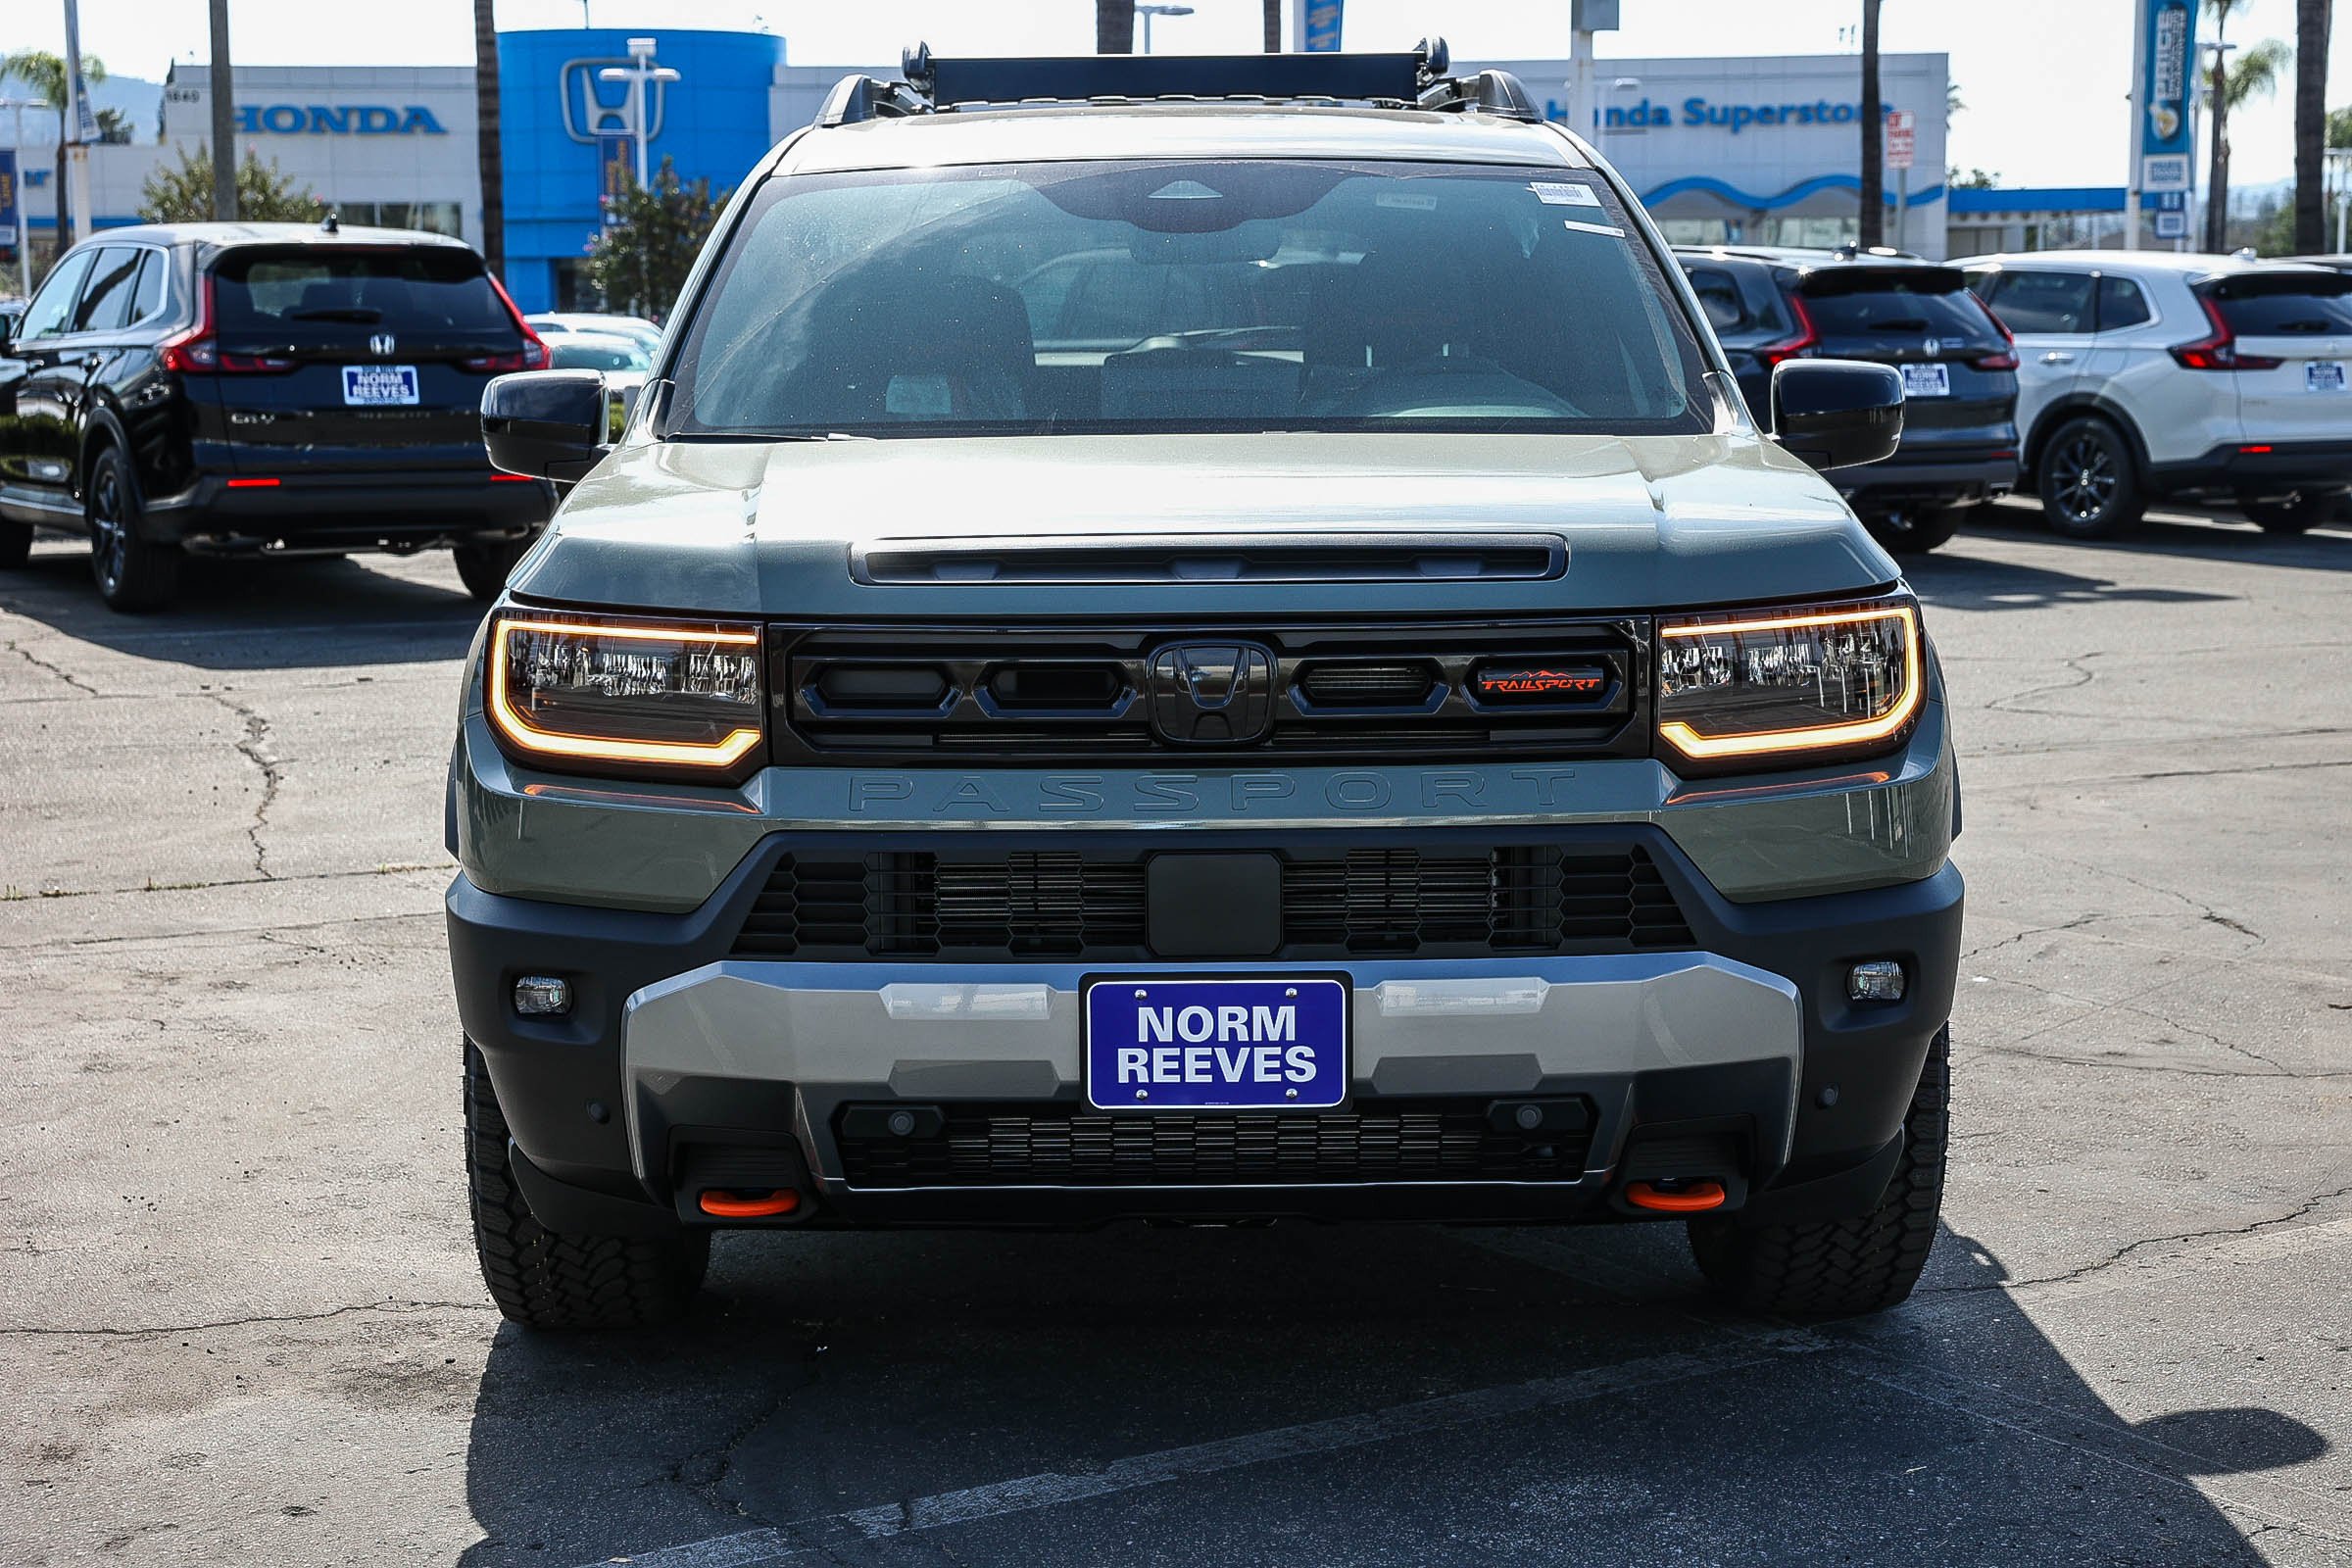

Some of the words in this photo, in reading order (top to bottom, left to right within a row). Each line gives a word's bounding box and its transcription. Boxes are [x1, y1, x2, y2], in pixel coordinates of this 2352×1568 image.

[232, 105, 449, 135] HONDA
[1545, 97, 1672, 127] Hnda
[352, 384, 410, 398] REEVES
[357, 372, 404, 384] NORM
[1481, 678, 1600, 692] TRAILSPORT
[848, 768, 1577, 813] PASSPORT
[1138, 1005, 1296, 1043] NORM
[1117, 1046, 1317, 1084] REEVES
